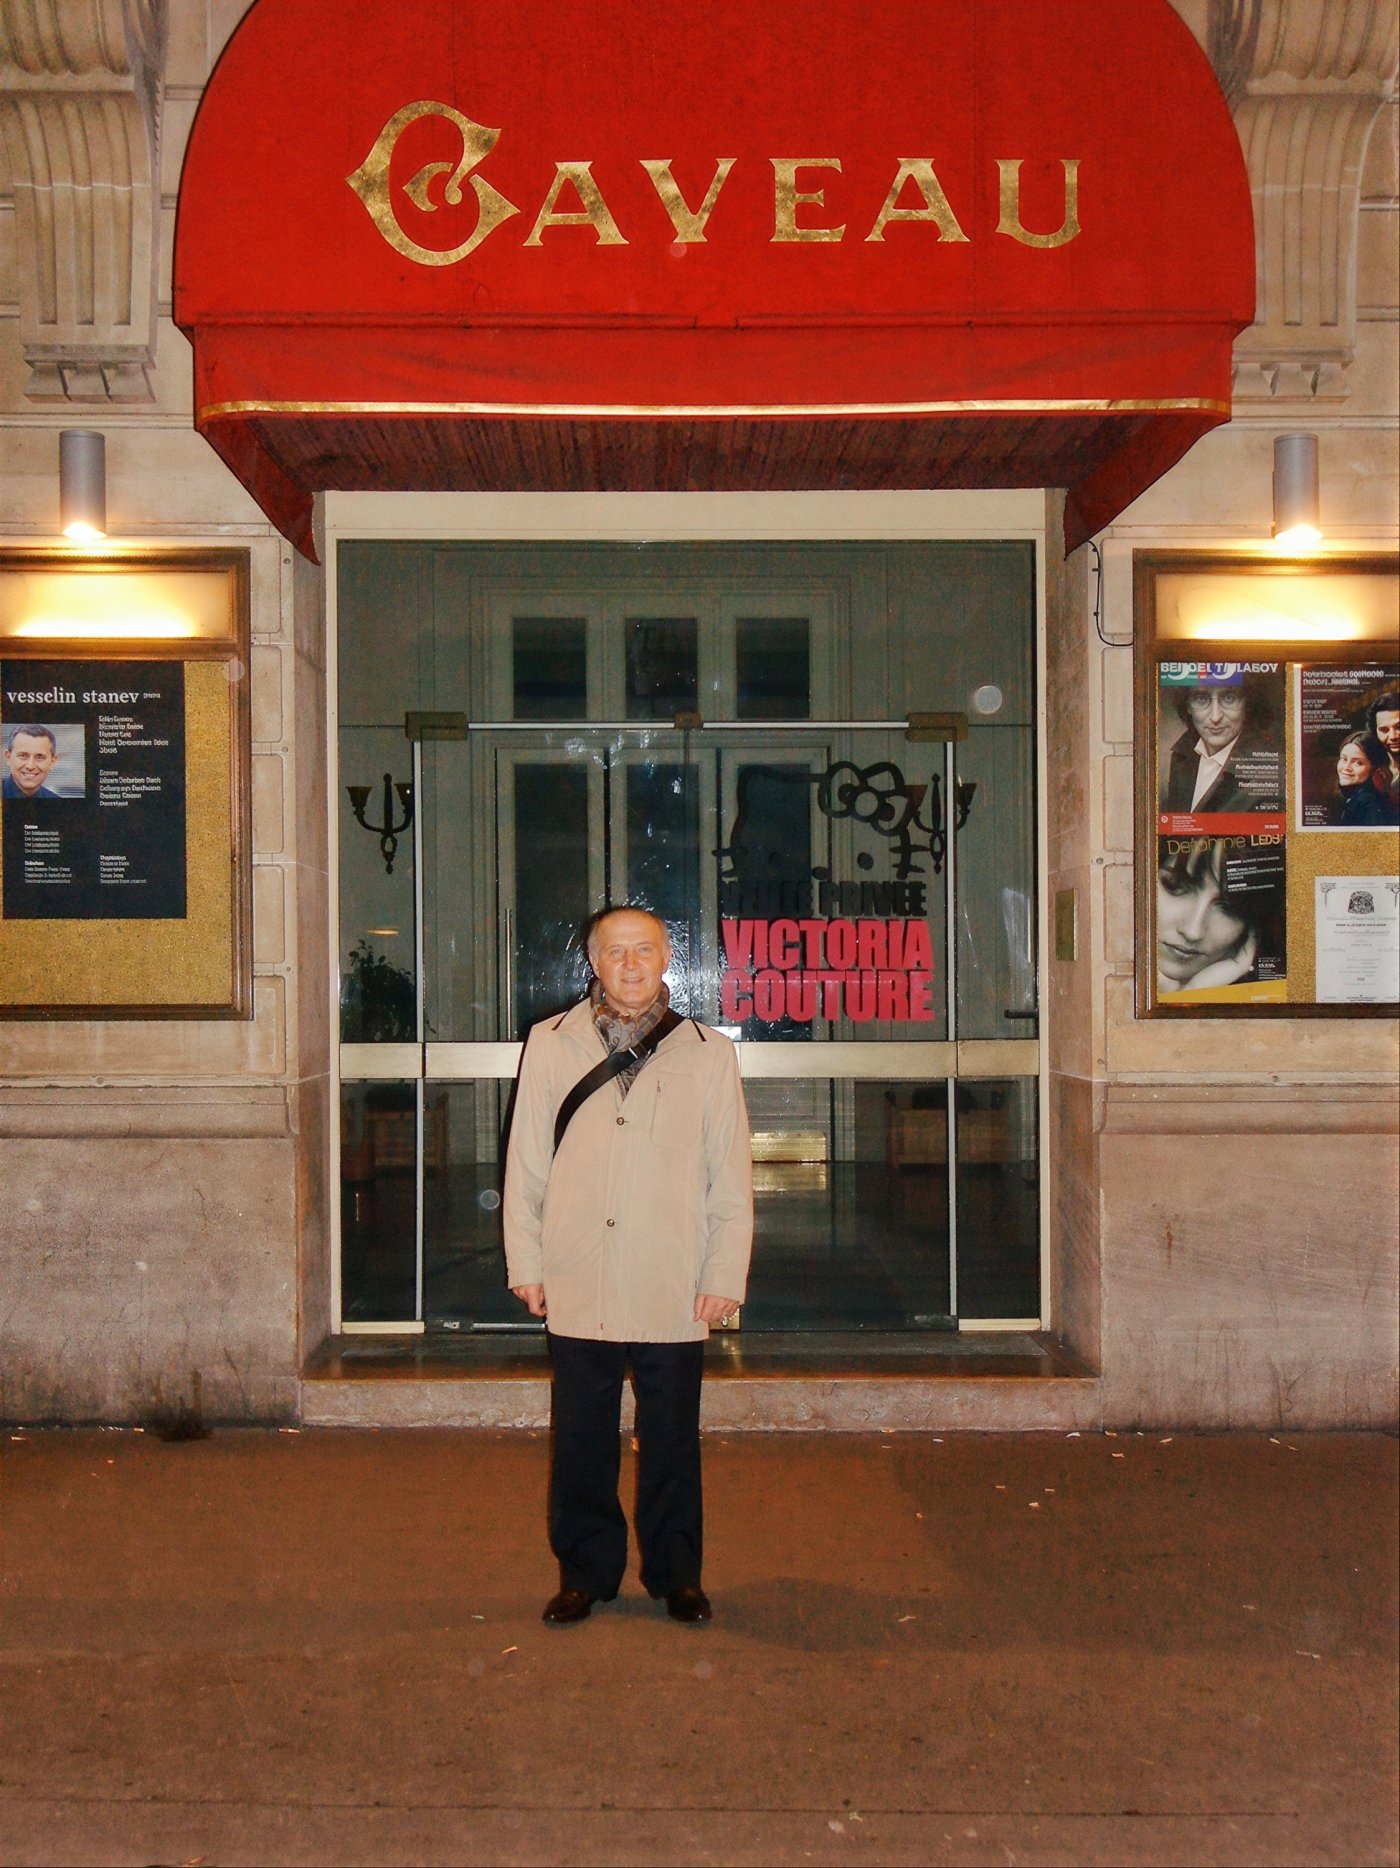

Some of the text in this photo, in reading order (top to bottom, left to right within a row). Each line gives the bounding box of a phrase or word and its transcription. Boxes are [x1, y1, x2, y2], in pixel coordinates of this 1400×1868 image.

[345, 100, 1082, 267] GAVEAU
[7, 686, 77, 704] vesselin
[83, 689, 140, 704] stanev
[721, 918, 935, 969] VICTORIA
[721, 969, 934, 1022] COUTURE
